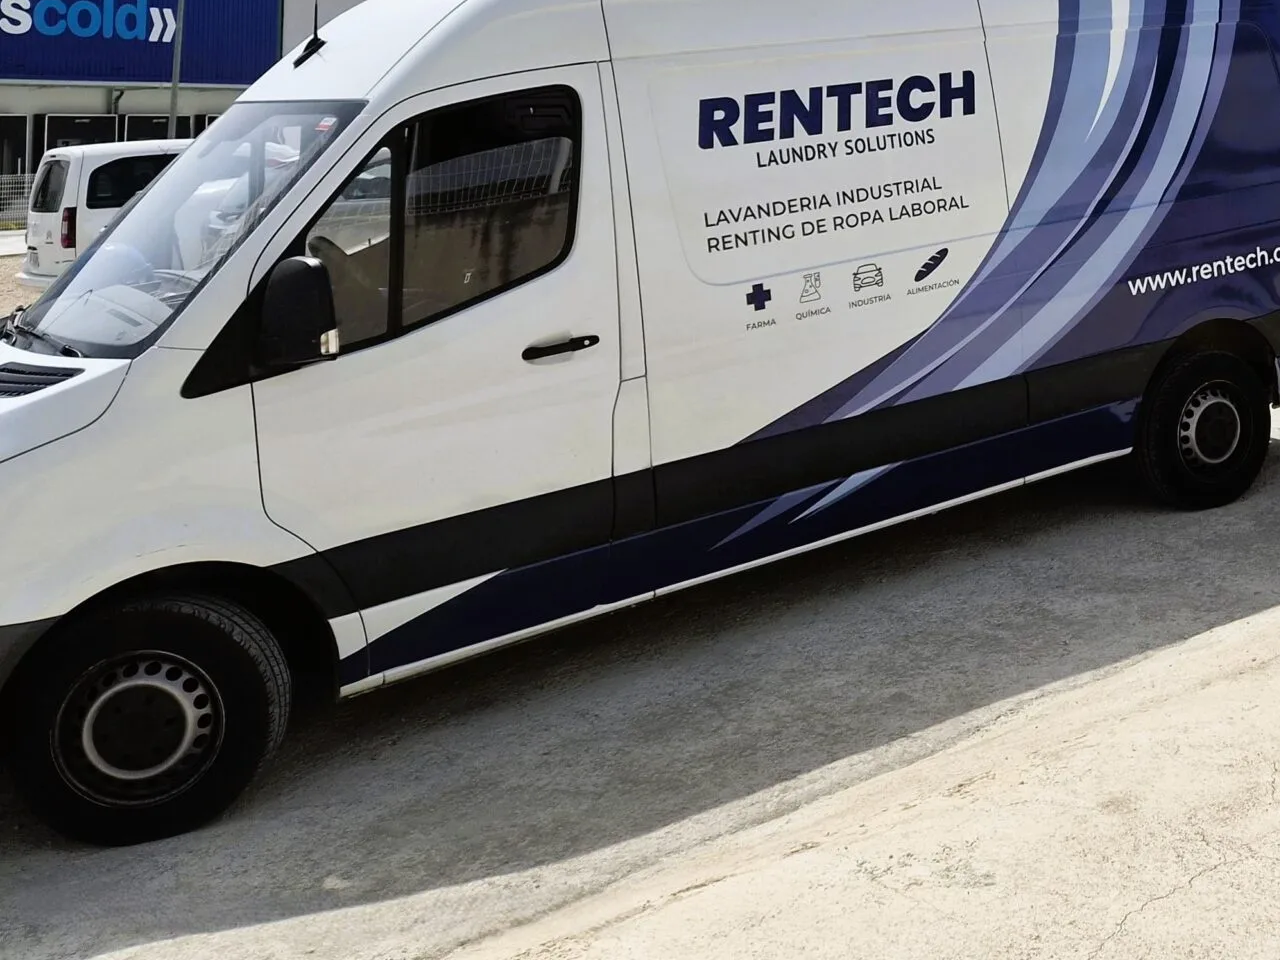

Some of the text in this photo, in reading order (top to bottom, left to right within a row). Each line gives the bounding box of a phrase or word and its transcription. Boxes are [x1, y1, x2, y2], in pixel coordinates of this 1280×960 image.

[698, 70, 976, 149] RENTECH
[756, 128, 935, 168] LAUNDRY SOLUTIONS
[704, 176, 943, 227] LAVANDERIA INDUSTRIAL
[707, 195, 969, 253] RENTING DE ROPA LABORAL
[848, 293, 892, 309] INDUSTRIA
[906, 278, 960, 296] ALIMENTACIÓN
[746, 318, 777, 331] FARMA
[795, 306, 831, 321] QUÍMICA
